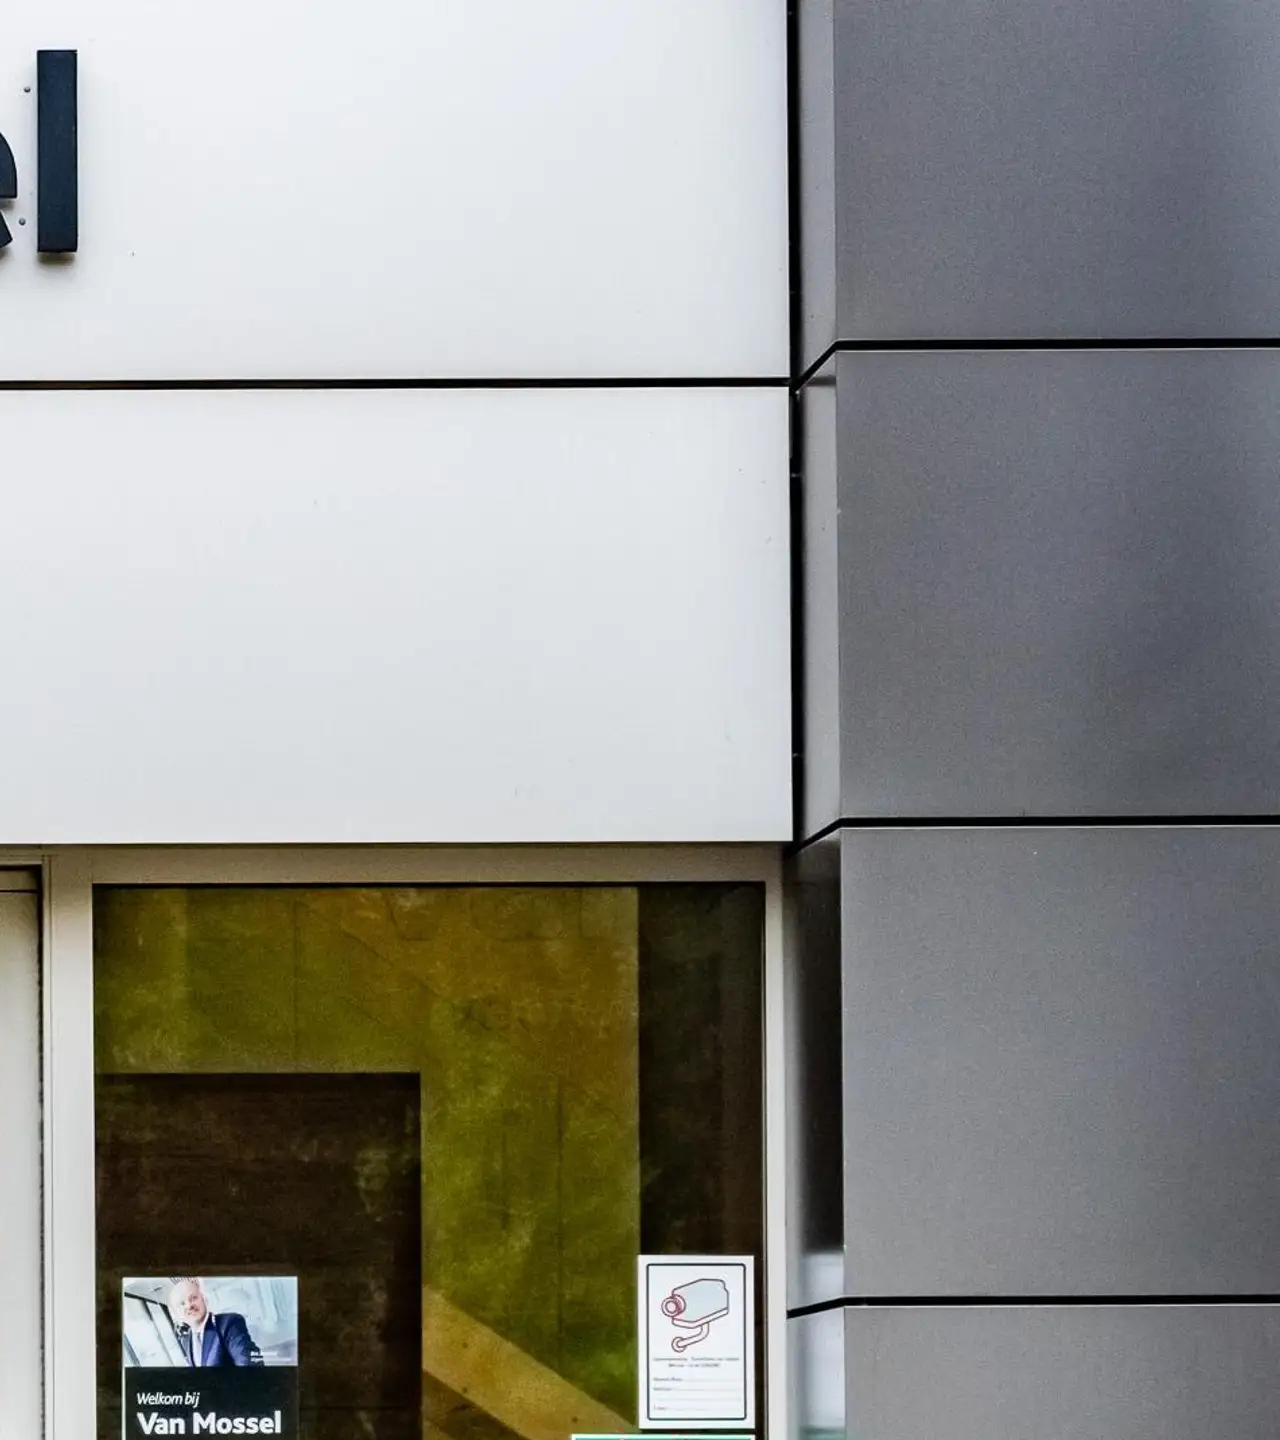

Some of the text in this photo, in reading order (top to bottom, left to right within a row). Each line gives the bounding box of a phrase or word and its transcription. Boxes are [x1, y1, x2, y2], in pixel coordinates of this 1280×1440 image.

[137, 1391, 201, 1408] Welkom bij
[136, 1410, 282, 1435] Van Mossel
